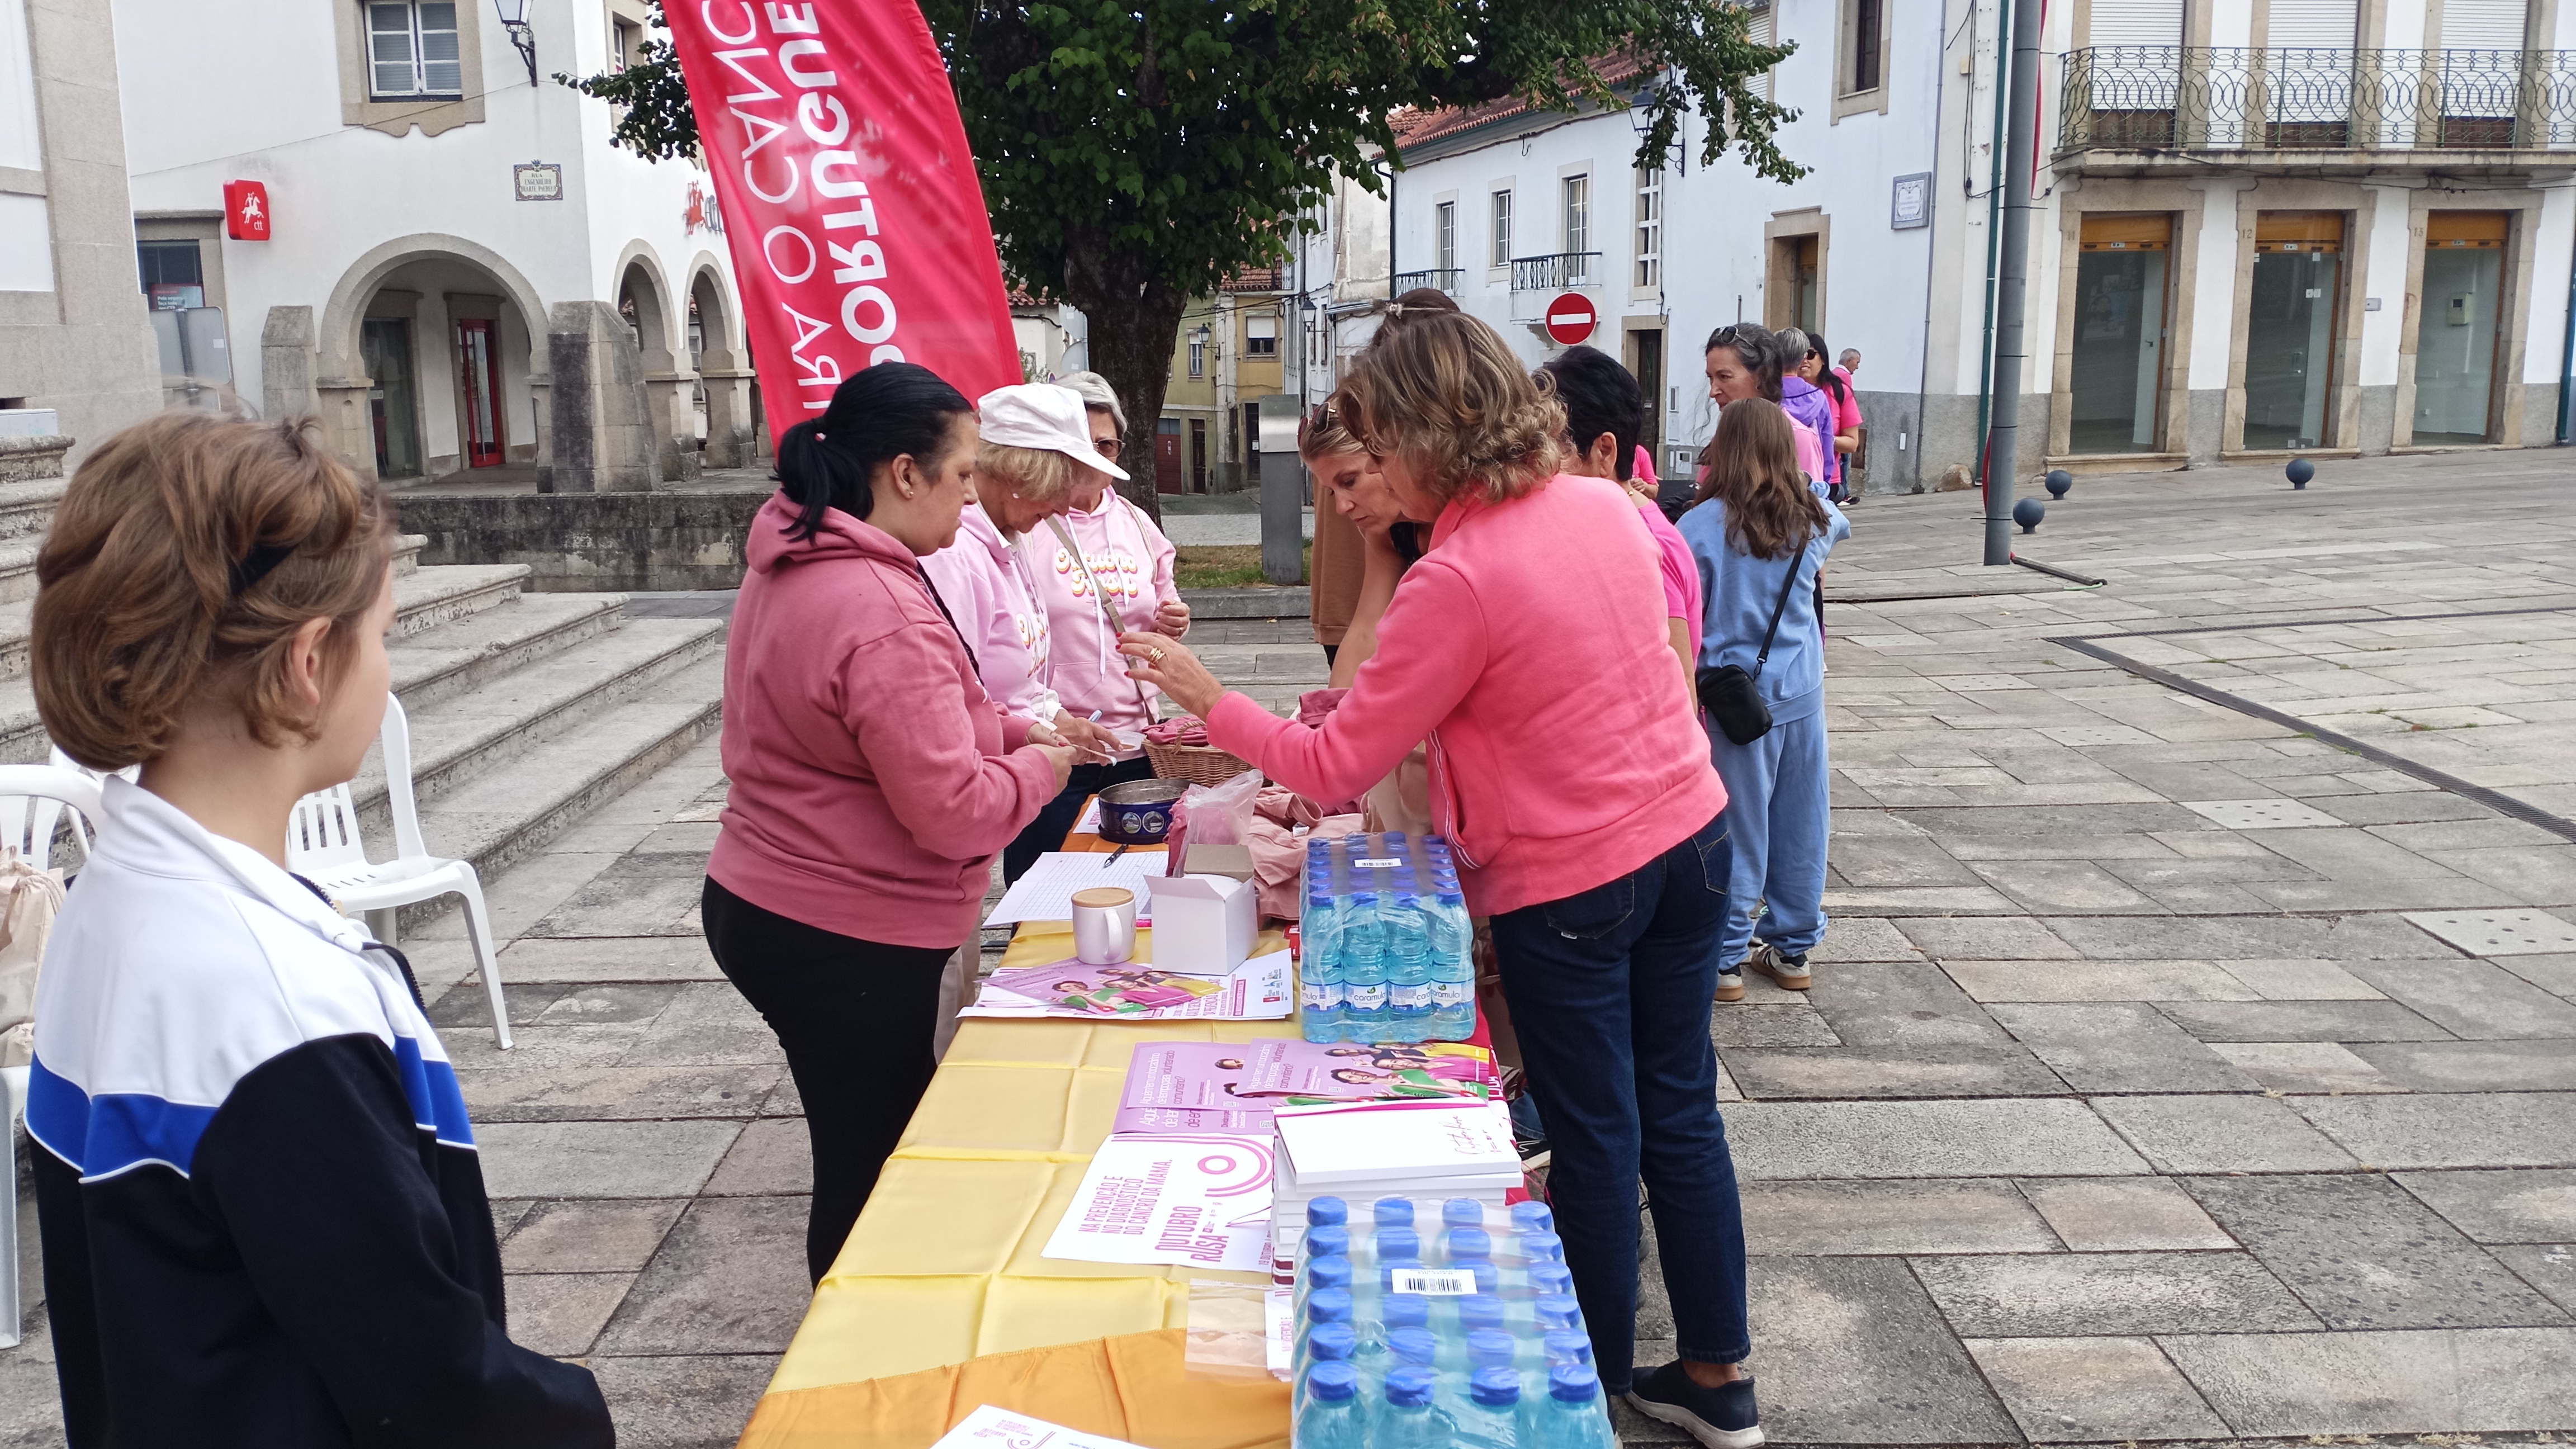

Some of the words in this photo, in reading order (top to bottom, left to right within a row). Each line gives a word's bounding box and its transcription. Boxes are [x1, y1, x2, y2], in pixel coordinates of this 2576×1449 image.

[254, 220, 263, 230] ctt
[2242, 229, 2252, 239] 12
[2413, 228, 2423, 236] 13
[1354, 991, 1386, 1001] caramulo
[1161, 1119, 1178, 1127] de
[1184, 1119, 1200, 1127] de
[1145, 1159, 1172, 1185] MAMA.
[1141, 1187, 1162, 1197] DA
[1086, 1182, 1120, 1222] PREVENÇÃO
[1106, 1178, 1144, 1223] DIAGNÓSTICO
[1129, 1198, 1158, 1224] CANCRO
[1078, 1224, 1101, 1233] NA
[1101, 1225, 1123, 1234] NO
[1123, 1226, 1145, 1235] DO
[1155, 1206, 1203, 1251] OUTUBRO
[1190, 1235, 1230, 1262] ROSA
